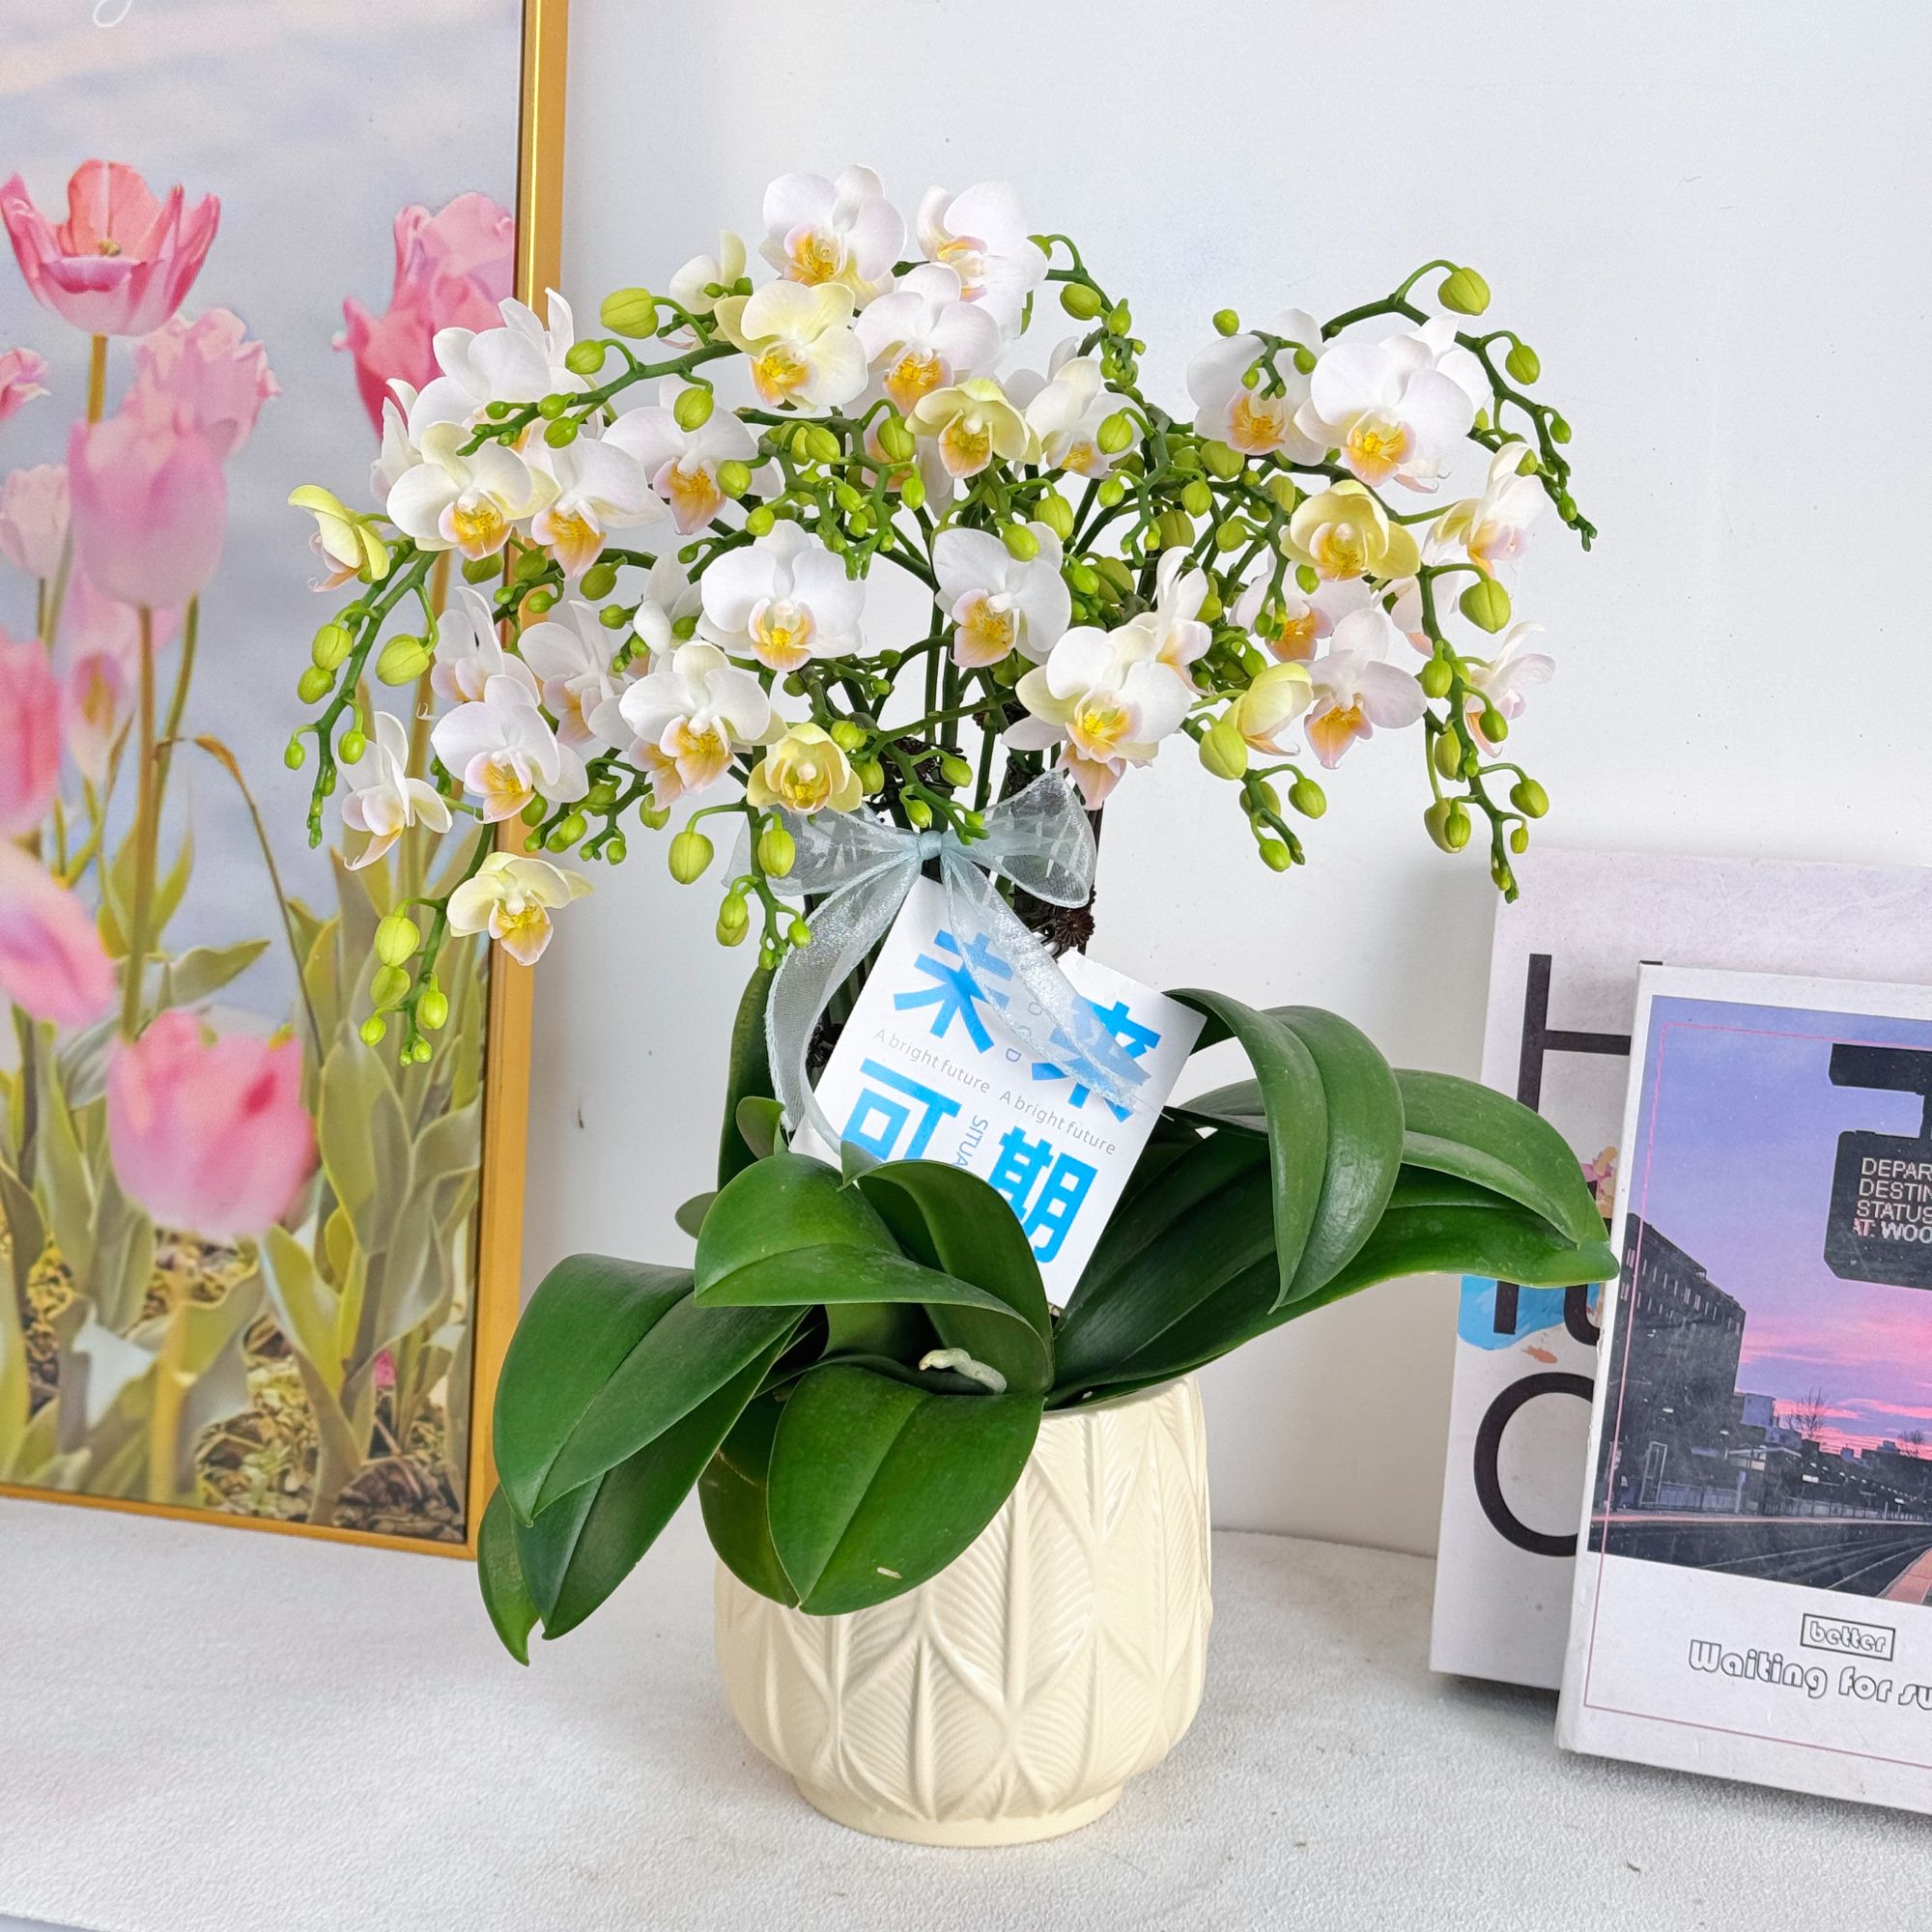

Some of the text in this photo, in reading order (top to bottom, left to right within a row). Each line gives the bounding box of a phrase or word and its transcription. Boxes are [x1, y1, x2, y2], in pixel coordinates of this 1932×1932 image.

[873, 1028, 1117, 1155] A bright future A bright future
[952, 1114, 988, 1167] SITUA
[1861, 1156, 1932, 1181] DEPAR
[1859, 1178, 1932, 1203] DESTIN
[1856, 1199, 1932, 1225] STATUS
[1809, 1620, 1887, 1654] better
[1688, 1639, 1829, 1700] Waiting
[1837, 1665, 1893, 1703] for
